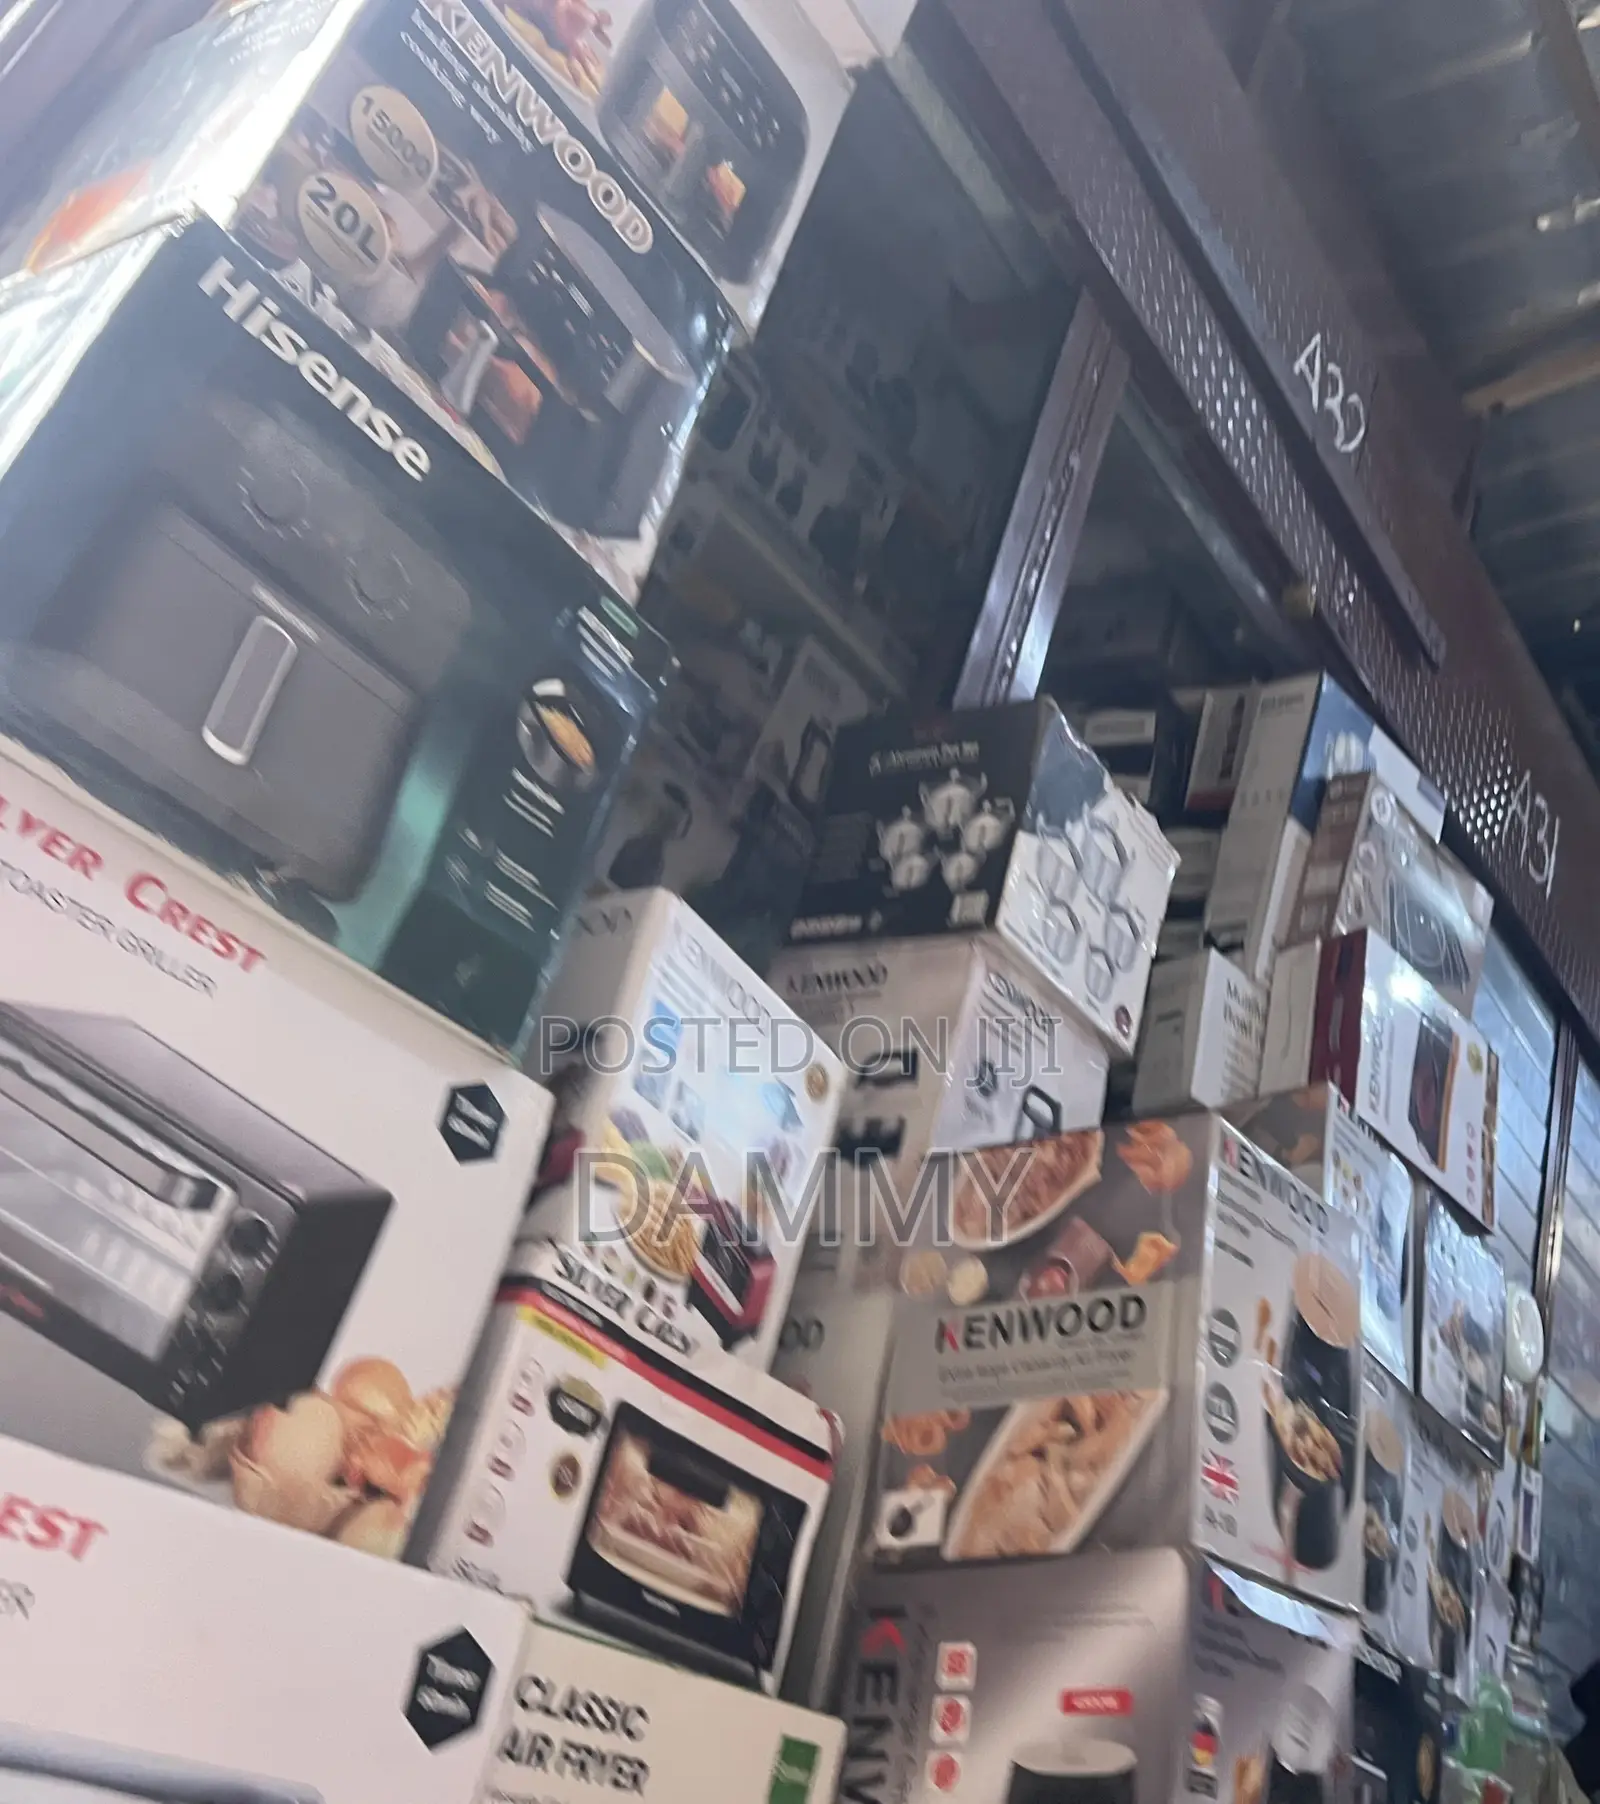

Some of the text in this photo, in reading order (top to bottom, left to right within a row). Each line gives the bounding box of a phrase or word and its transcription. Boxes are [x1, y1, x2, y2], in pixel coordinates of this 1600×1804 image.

[198, 256, 430, 482] Hisense
[1502, 769, 1560, 901] A31
[124, 873, 267, 973] CREST
[935, 1293, 1147, 1354] KENWOOD
[513, 1674, 651, 1743] CLASSIC
[498, 1726, 651, 1799] AIR FRYER
